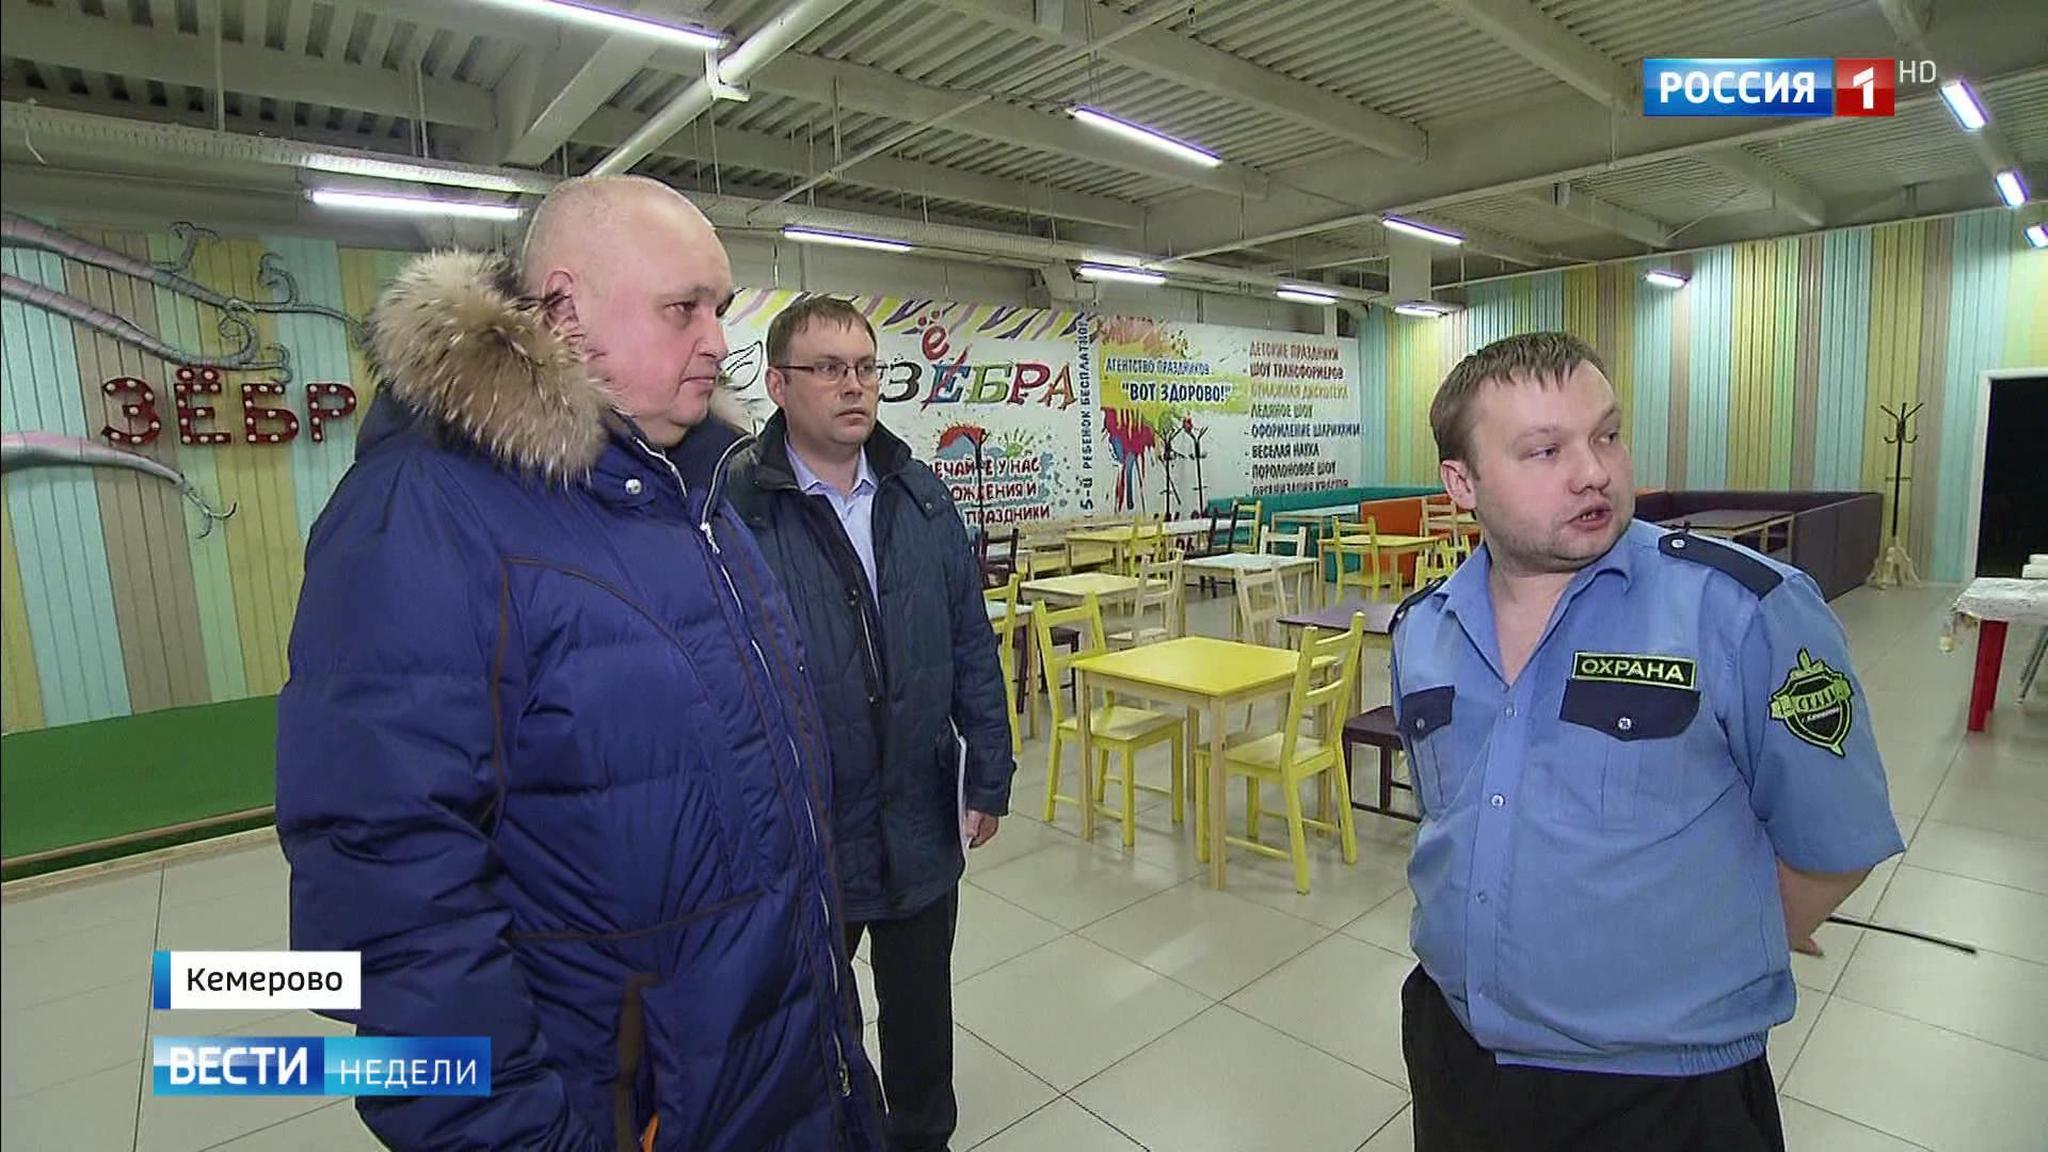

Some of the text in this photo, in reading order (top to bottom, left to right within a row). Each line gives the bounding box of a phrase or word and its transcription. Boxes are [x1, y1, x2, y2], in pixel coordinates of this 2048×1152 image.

[1290, 344, 1339, 360] ПРАЗДНИКИ
[1106, 358, 1210, 375] АГЕНТСТВО ПРАЗДНИКОВ
[1250, 361, 1344, 379] ШОУ ТРАНСФОРМЕРОВ
[1122, 382, 1231, 403] "ВОТ ЗДОРОВО!"
[1251, 402, 1313, 418] ЛЕДЯНОЕ ШОУ
[1081, 410, 1092, 469] РЕБЕНОК
[1251, 422, 1310, 438] ОФОРМЛЕНИЕ
[1252, 442, 1320, 459] ВЕСЕЛАЯ НАУКА
[998, 460, 1007, 476] У
[1011, 457, 1040, 474] НАС
[1252, 460, 1336, 479] ПОРОЛОНОВОЕ ШОУ
[951, 481, 1036, 501] ОЖДЕНИЯ И
[965, 505, 1050, 525] ПРАЗДНИКИ
[1580, 658, 1685, 682] ОХРАНА
